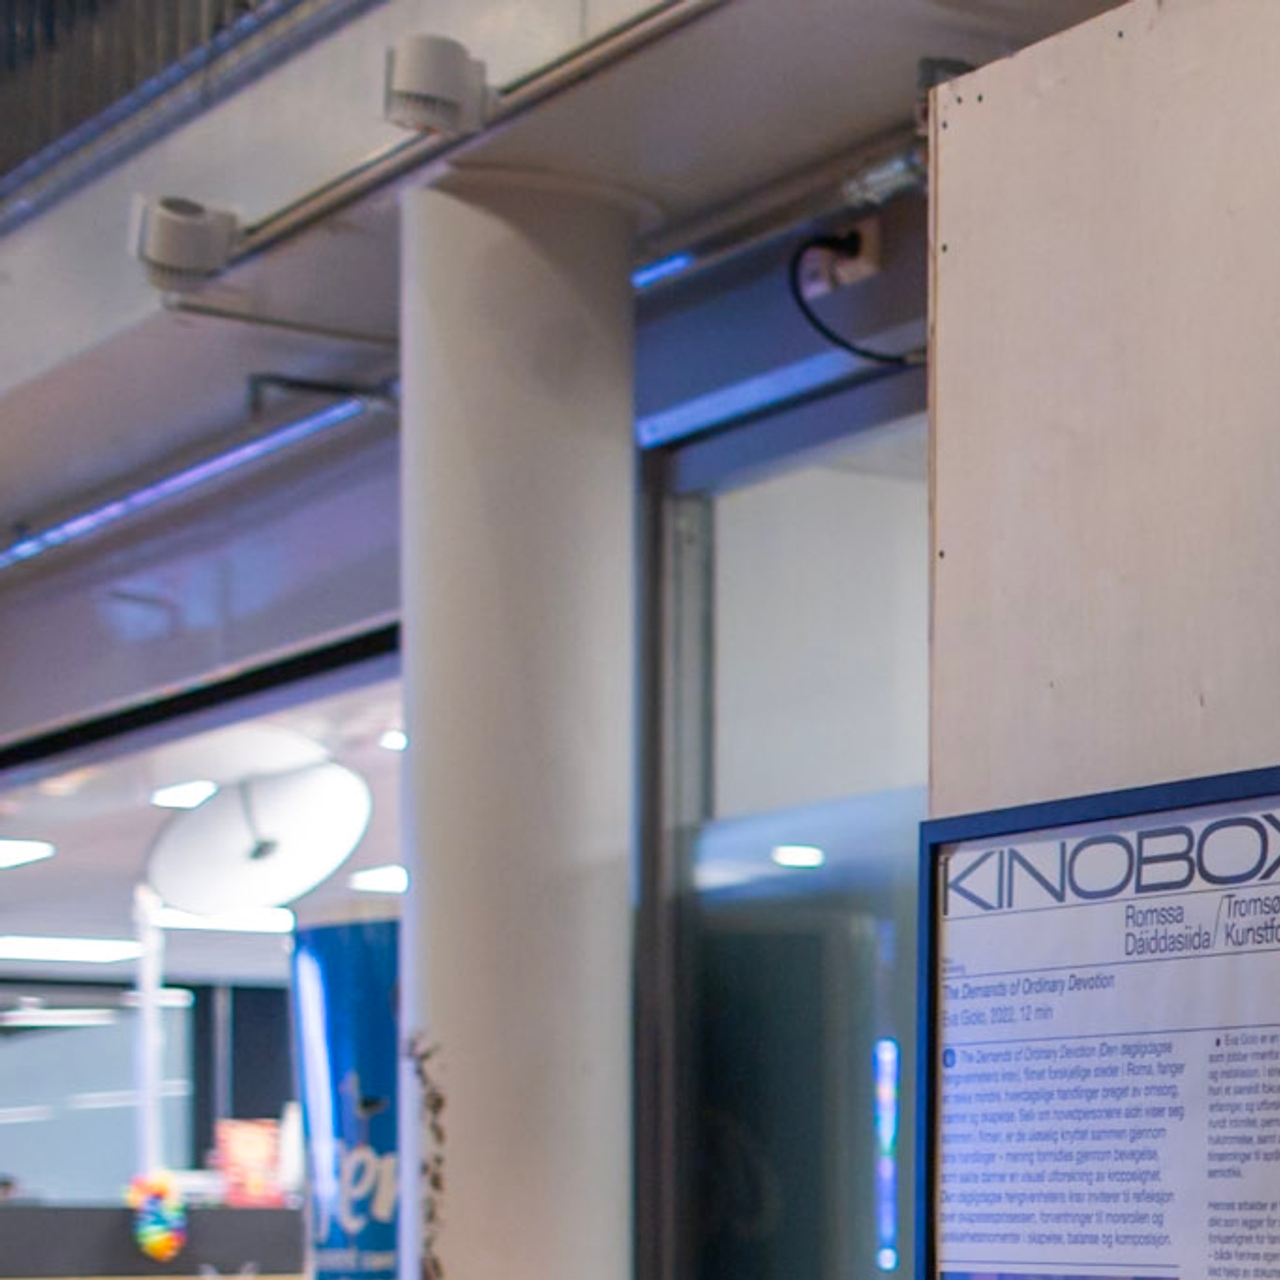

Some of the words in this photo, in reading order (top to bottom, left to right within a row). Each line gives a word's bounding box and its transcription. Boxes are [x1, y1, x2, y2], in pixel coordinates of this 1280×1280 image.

[1125, 903, 1184, 928] Romssa
[961, 983, 1007, 999] Demands
[1010, 979, 1020, 996] of
[1022, 977, 1065, 996] Ordinary
[1067, 974, 1116, 991] Devotion
